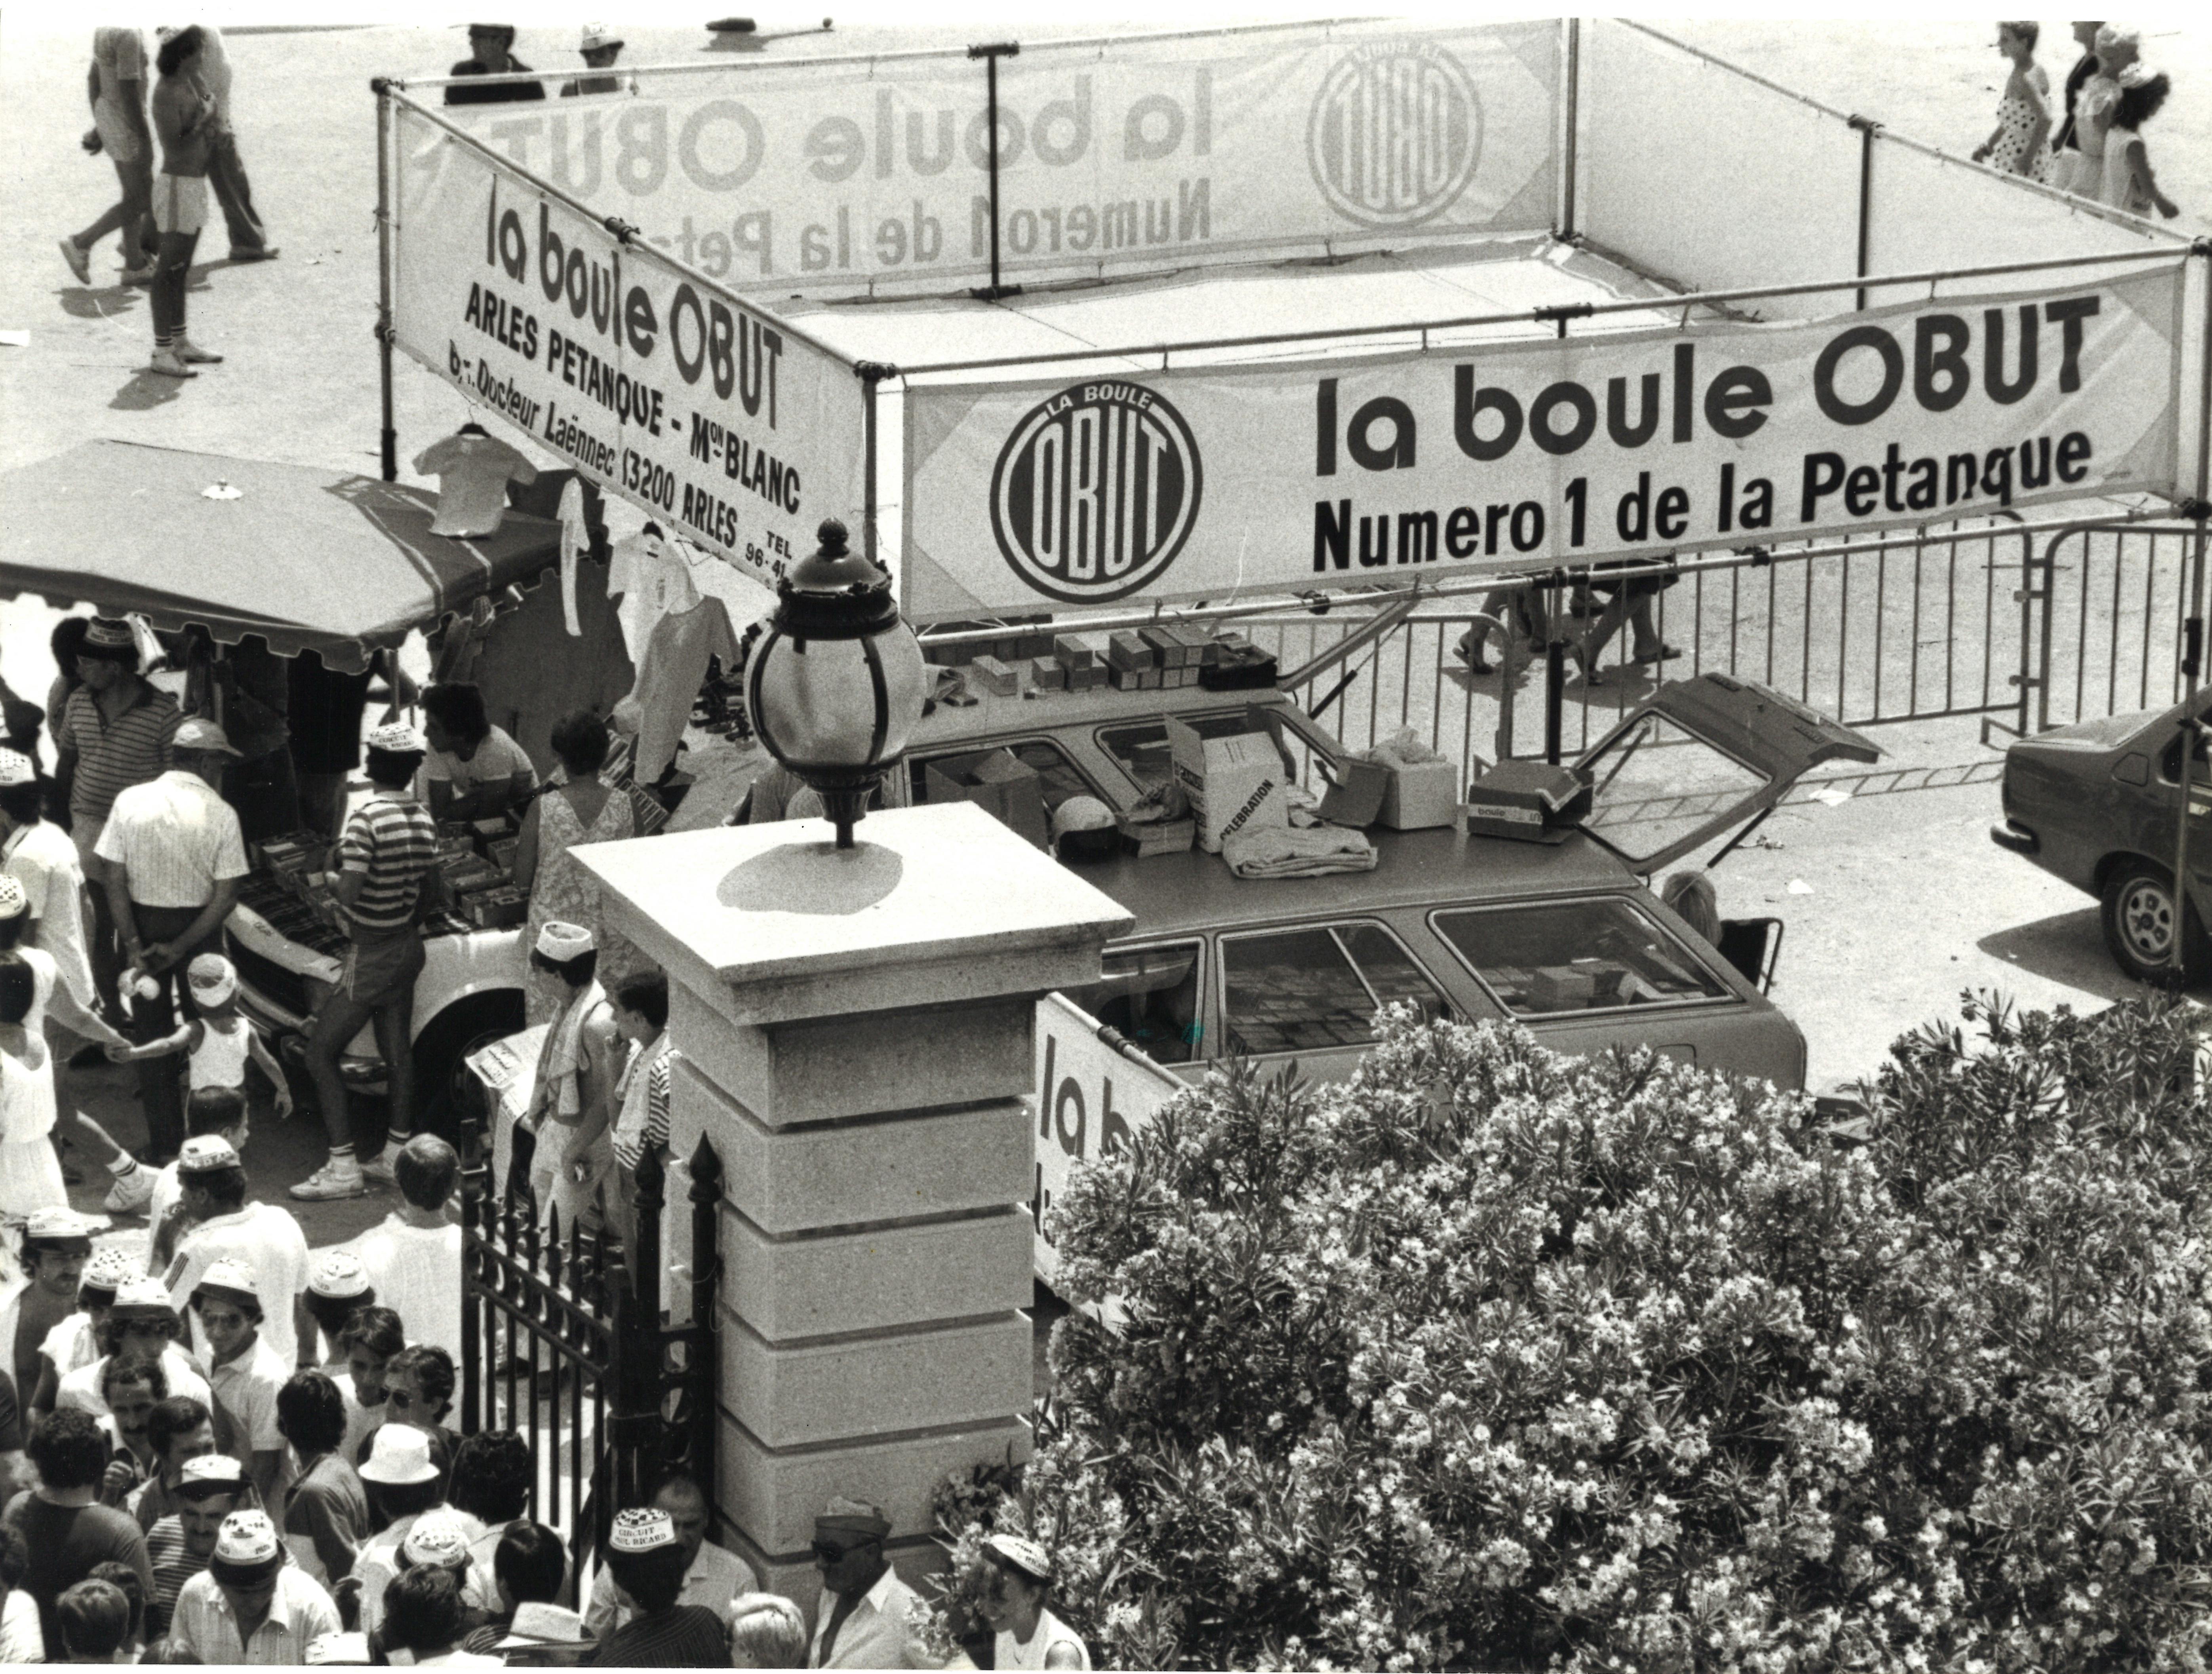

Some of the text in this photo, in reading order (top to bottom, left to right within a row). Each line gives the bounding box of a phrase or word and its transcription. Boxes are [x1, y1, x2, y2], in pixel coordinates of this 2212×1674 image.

[487, 173, 782, 430] la boule OBUT
[464, 282, 537, 360] ARLES
[548, 329, 664, 436] PETANQUE
[725, 430, 800, 515] BLANC
[477, 357, 540, 430] Docteur
[544, 401, 615, 476] Laënnec
[622, 447, 675, 512] 13200
[682, 483, 738, 548] ARLES
[1046, 383, 1152, 416] LA BOULE
[1317, 295, 2100, 476] la boule OBUT
[767, 530, 792, 560] TEL
[1032, 406, 1167, 580] OBUT
[1314, 431, 2092, 572] Numero 1 de la Petanque
[1040, 1034, 1086, 1159] la
[633, 1533, 666, 1545] RICARD
